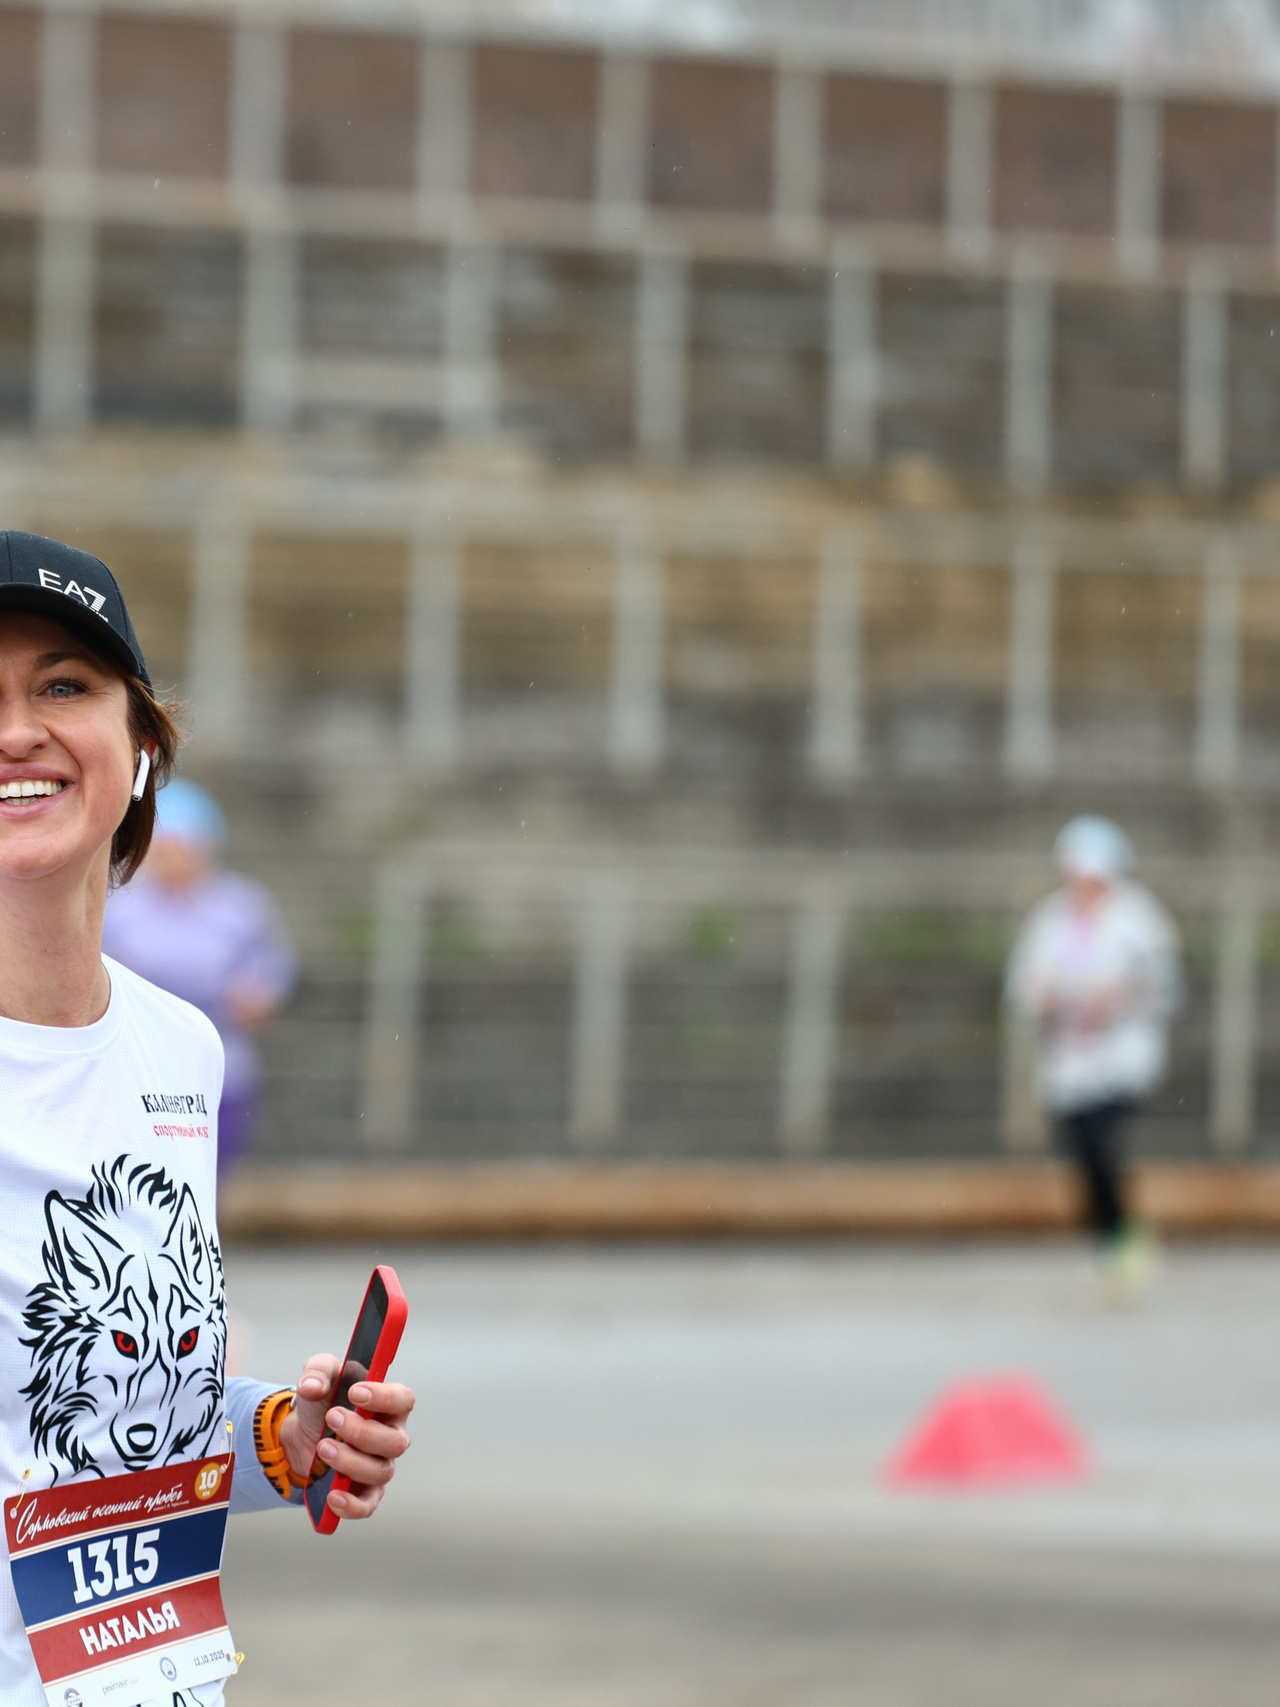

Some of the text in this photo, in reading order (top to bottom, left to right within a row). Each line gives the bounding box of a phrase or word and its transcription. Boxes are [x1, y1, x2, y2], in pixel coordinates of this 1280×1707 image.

[198, 1469, 218, 1491] 10
[91, 1499, 142, 1519] осенний
[67, 1528, 160, 1604] 1315
[78, 1601, 181, 1656] НАТАЛЬЯ
[193, 1649, 225, 1667] 12.10.2025
